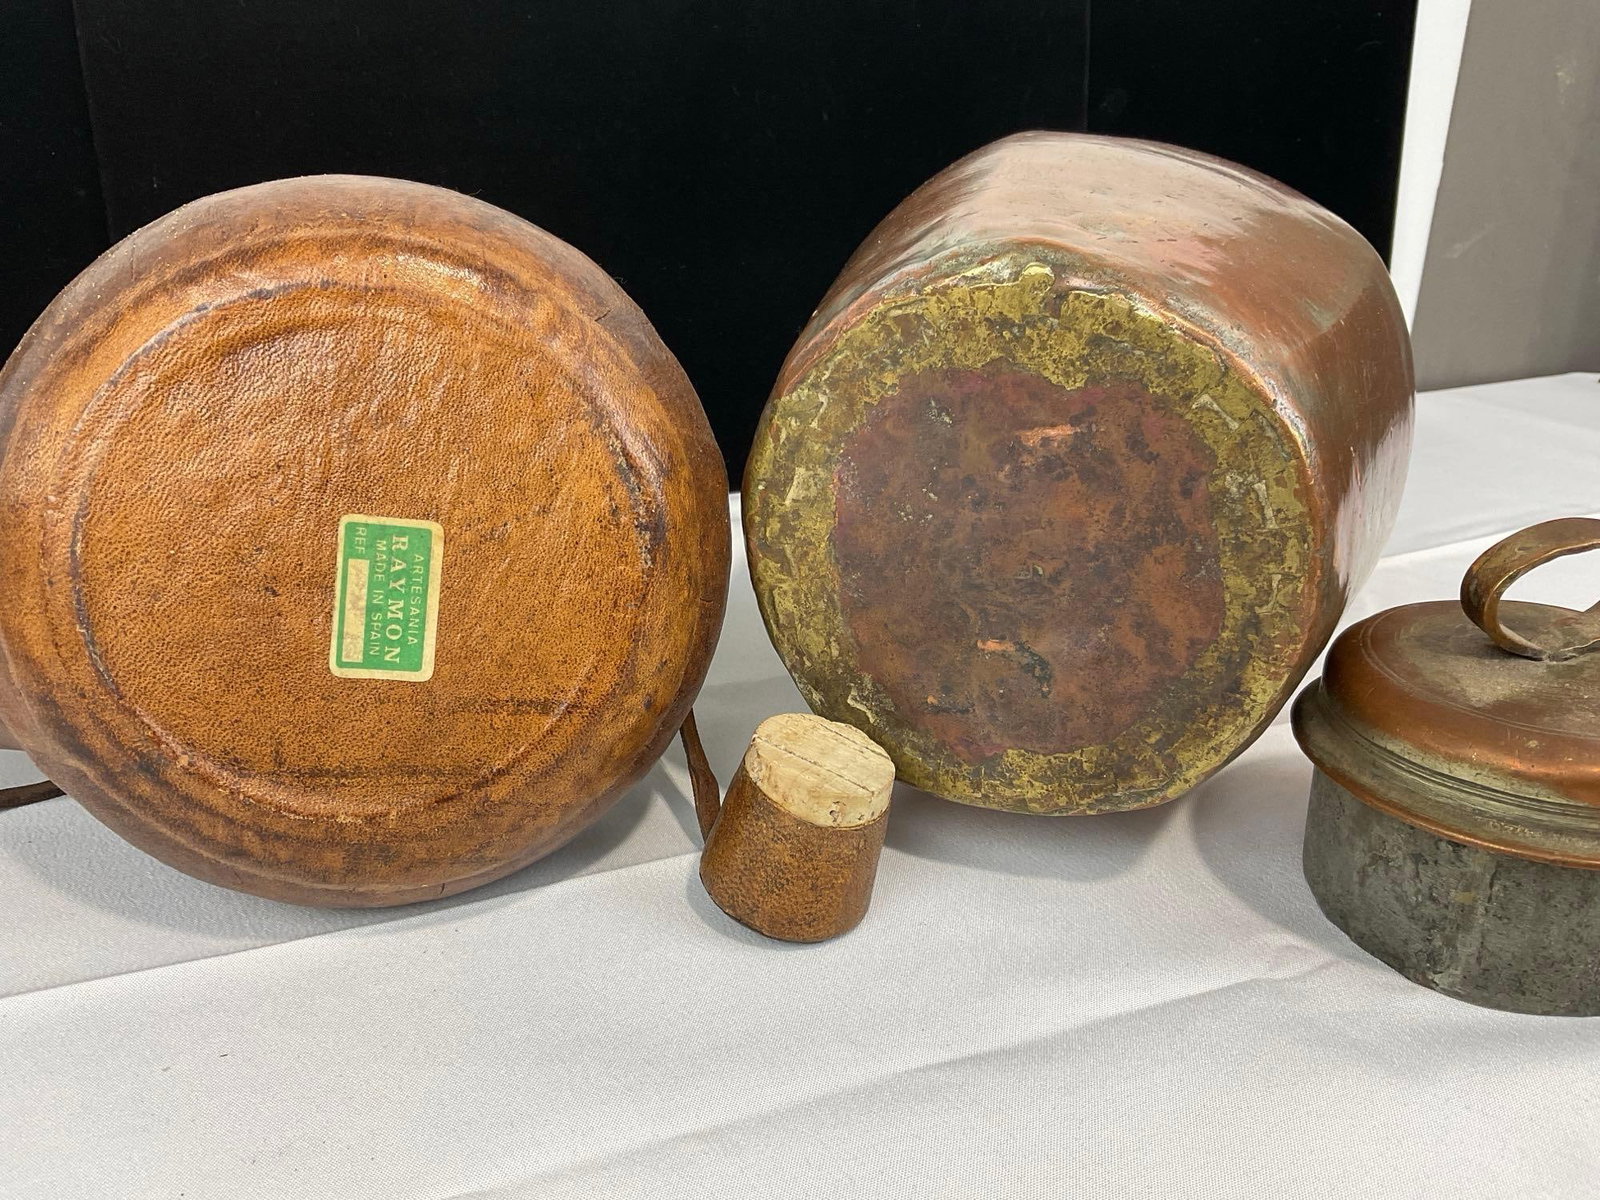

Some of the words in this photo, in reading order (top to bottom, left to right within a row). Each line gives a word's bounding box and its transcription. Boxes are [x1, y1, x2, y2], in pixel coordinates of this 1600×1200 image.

[355, 526, 367, 554] REF
[373, 540, 387, 582] MADE
[371, 590, 384, 604] IN
[384, 535, 409, 664] RAYMON
[407, 554, 424, 645] ARTESANIA
[369, 612, 382, 656] SPAIN
